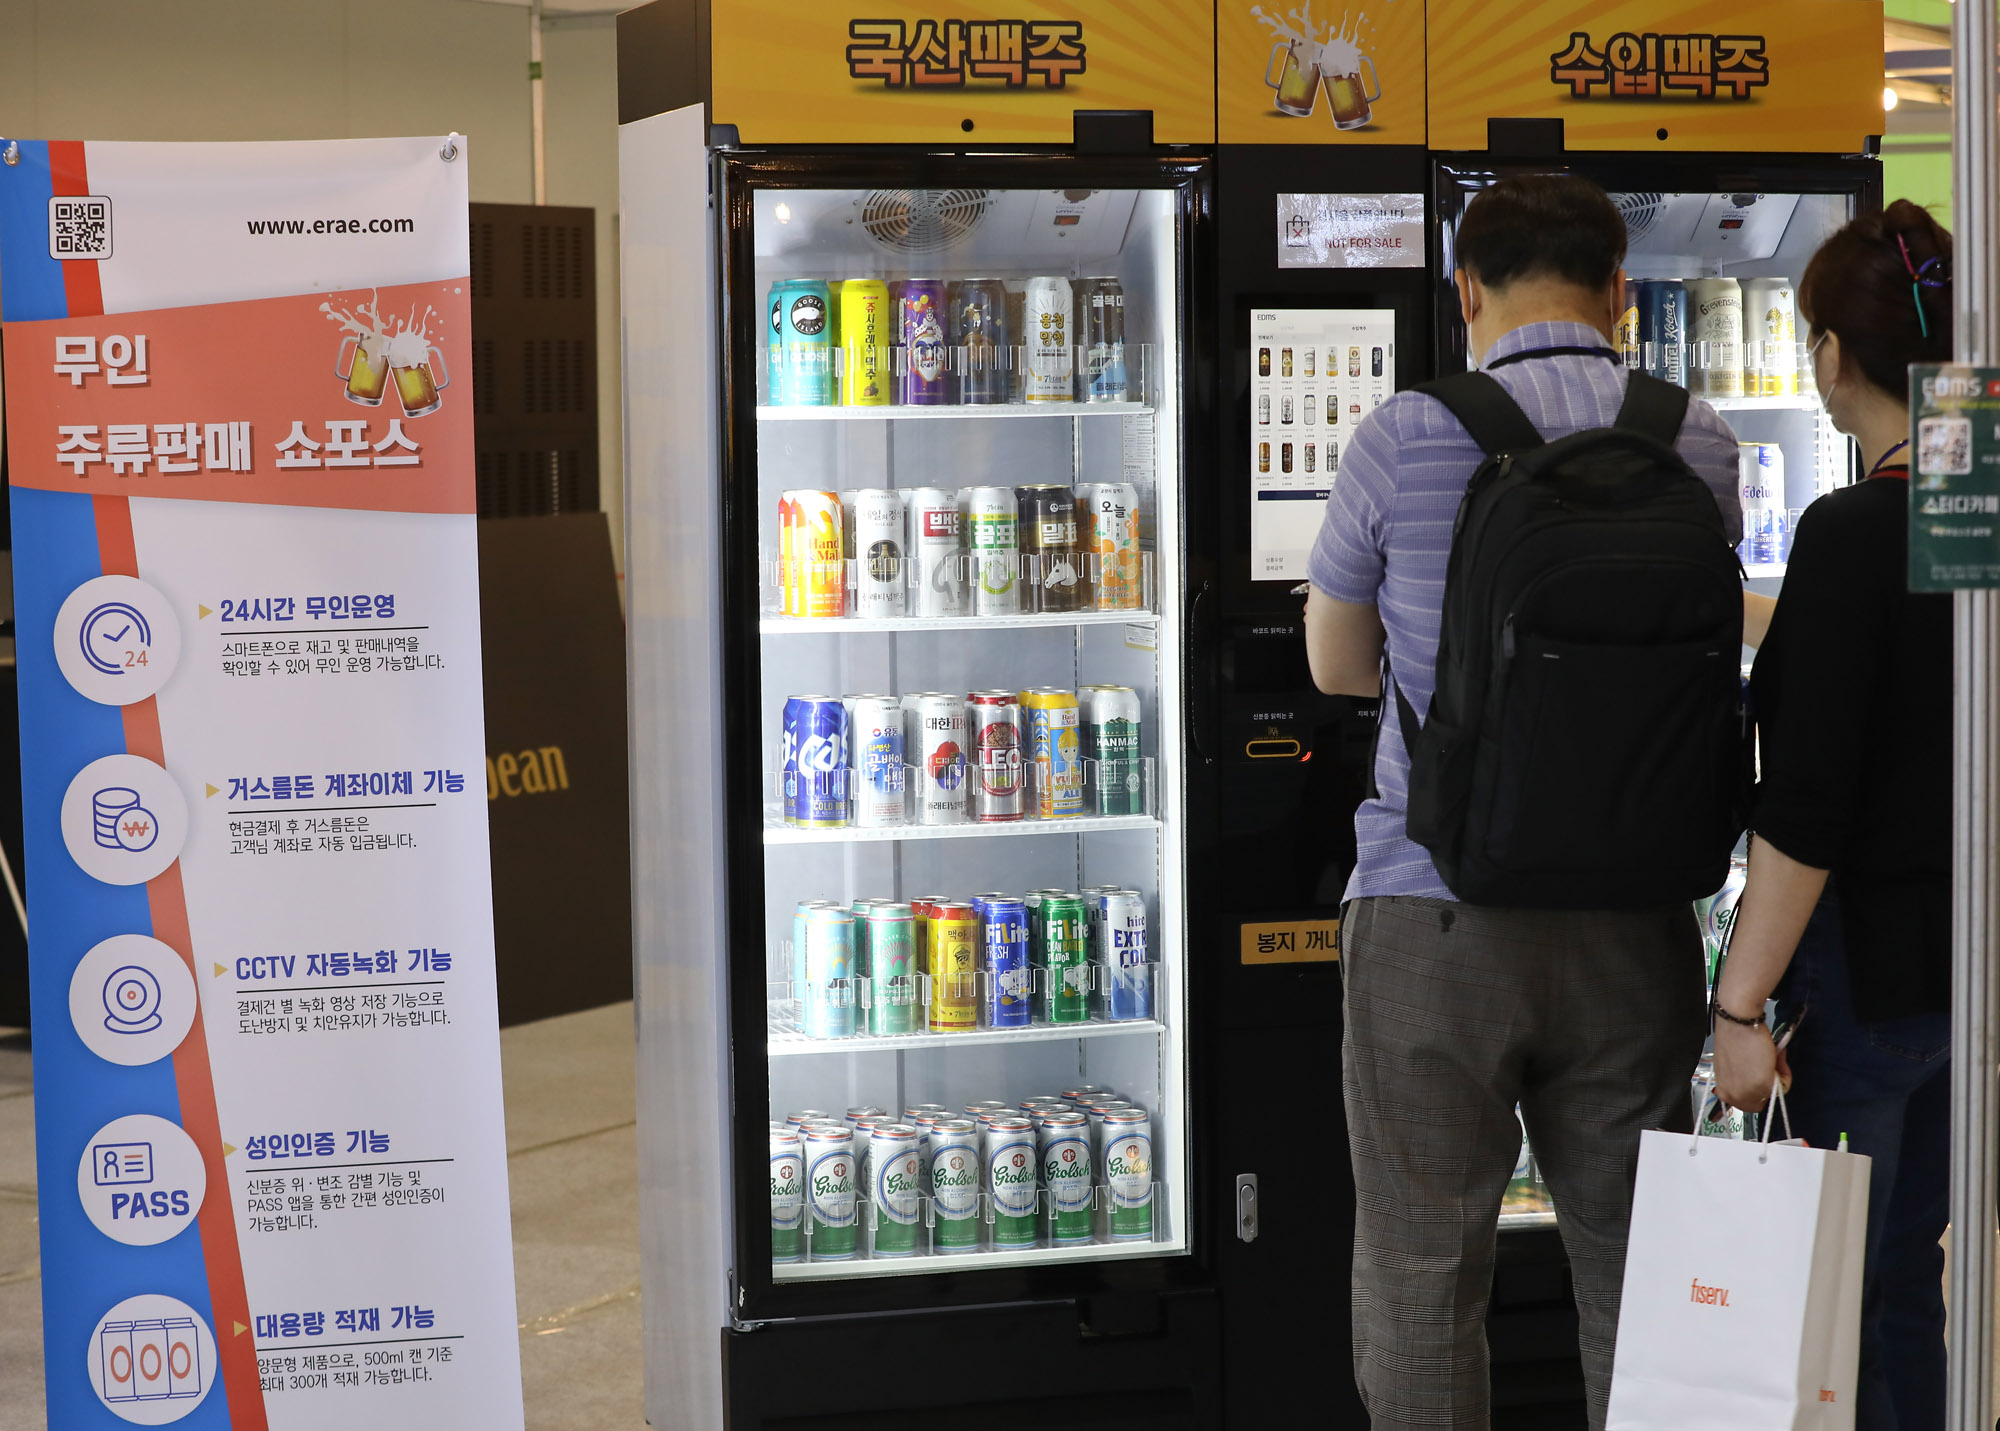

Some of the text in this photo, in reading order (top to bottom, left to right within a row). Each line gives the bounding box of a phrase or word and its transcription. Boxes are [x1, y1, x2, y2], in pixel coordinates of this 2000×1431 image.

[846, 19, 1086, 88] 국산맥주
[1551, 32, 1769, 99] 수입맥주
[247, 216, 414, 235] www.erae.com
[1325, 238, 1402, 248] NOT FOR SALE
[1040, 313, 1065, 329] 흥청
[1040, 331, 1065, 348] 망청
[54, 334, 149, 385] 무인
[56, 418, 419, 475] 주류판매 쇼포스
[1743, 485, 1773, 498] Edelw
[809, 537, 839, 549] Hand
[1041, 522, 1077, 544] 말표
[221, 594, 395, 622] 24시간 무인운영
[222, 636, 419, 657] 스마트폰으로 재고 및 판매내역을
[125, 650, 149, 668] 24
[222, 653, 445, 677] 확인할 수 있어 무인 운영 가능합니다.
[1096, 737, 1138, 746] HANMAC
[978, 749, 1021, 770] LEO
[228, 770, 465, 800] 거스름돈 계좌이체 기능
[229, 816, 369, 836] 현금결제 후 거스름돈은
[230, 834, 417, 855] 고객님 계좌로 자동 입금됩니다.
[986, 922, 1029, 943] FiLite
[1046, 919, 1089, 940] FiLite
[1114, 929, 1147, 947] EXTR
[986, 946, 1009, 959] FRESH
[1257, 932, 1295, 953] 봉지
[236, 948, 452, 980] CCTV 자동녹화 기능
[236, 992, 444, 1016] 결제건 별 녹화 영상 저장 기능으로
[238, 1010, 450, 1035] 도난방지 및 치안유지가 가능합니다.
[245, 1130, 390, 1160] 성인인증 기능
[933, 1166, 977, 1189] Grolsch
[1046, 1158, 1090, 1182] Grolsch
[1109, 1155, 1152, 1179] Grolsch
[246, 1178, 286, 1195] 신분증
[348, 1174, 373, 1191] 감별
[377, 1173, 403, 1188] 기능
[408, 1170, 422, 1187] 및
[112, 1189, 190, 1220] PASS
[248, 1188, 445, 1213] PASS 앱을 통한 간편 성인인증이
[249, 1215, 318, 1233] 가능합니다.
[1691, 1278, 1730, 1307] fiserv.
[255, 1306, 435, 1338] 대용량 적재 가능
[257, 1347, 453, 1374] 양문형 제품으로, 500ml 캔 기준
[259, 1367, 433, 1393] 최대 300개 적재 가능합니다.
